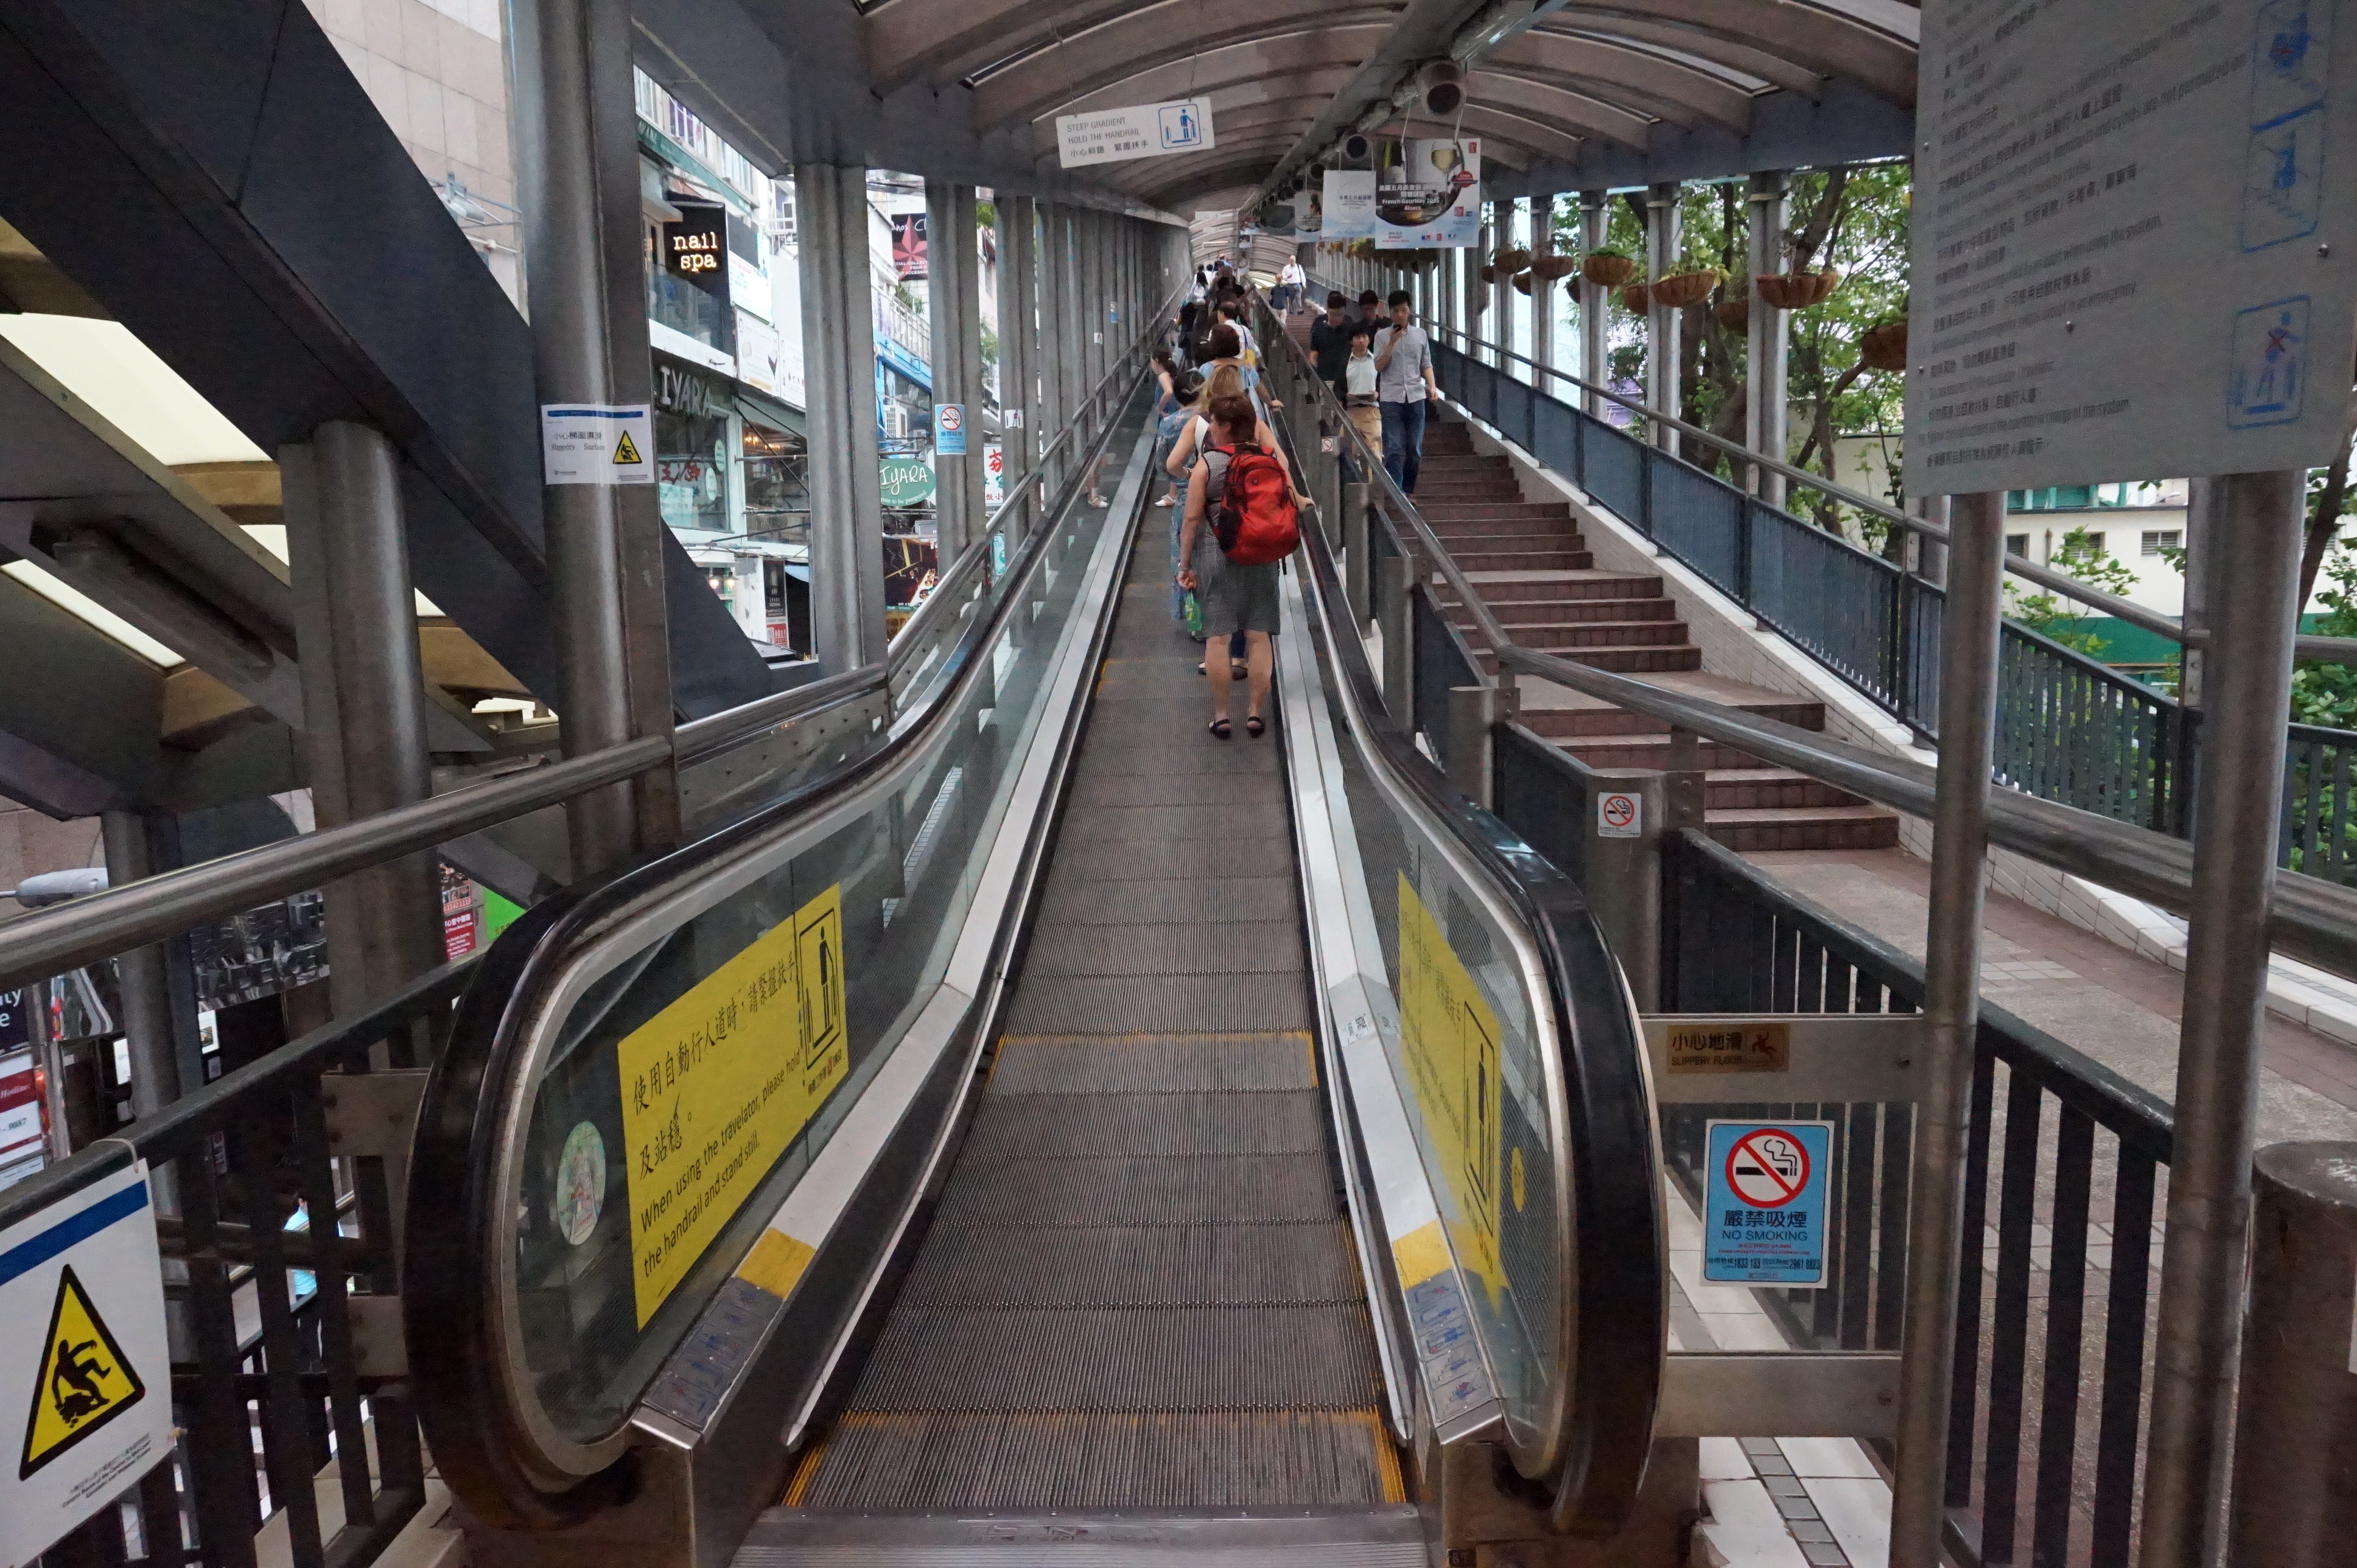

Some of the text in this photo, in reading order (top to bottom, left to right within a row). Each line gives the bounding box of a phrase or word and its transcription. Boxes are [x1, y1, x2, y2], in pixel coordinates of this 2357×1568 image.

[1067, 122, 1088, 132] STEEP
[1068, 135, 1087, 144] HOLD
[1105, 128, 1140, 139] HANDRAIL
[673, 231, 718, 250] nail
[681, 253, 716, 272] spa
[660, 365, 712, 419] IYARA
[552, 444, 575, 452] Slippery
[905, 490, 926, 505] pampered
[1672, 1032, 1742, 1051] 小心地滑
[1672, 1056, 1711, 1065] SLIPPERY
[641, 1049, 800, 1233] When using the travelator, please hold
[643, 1130, 760, 1278] the handrail and stand still.
[1723, 1209, 1807, 1228] 嚴禁吸煙
[1722, 1230, 1808, 1241] NO SMOKING
[1734, 1258, 1748, 1269] 1833
[1751, 1258, 1760, 1269] 183
